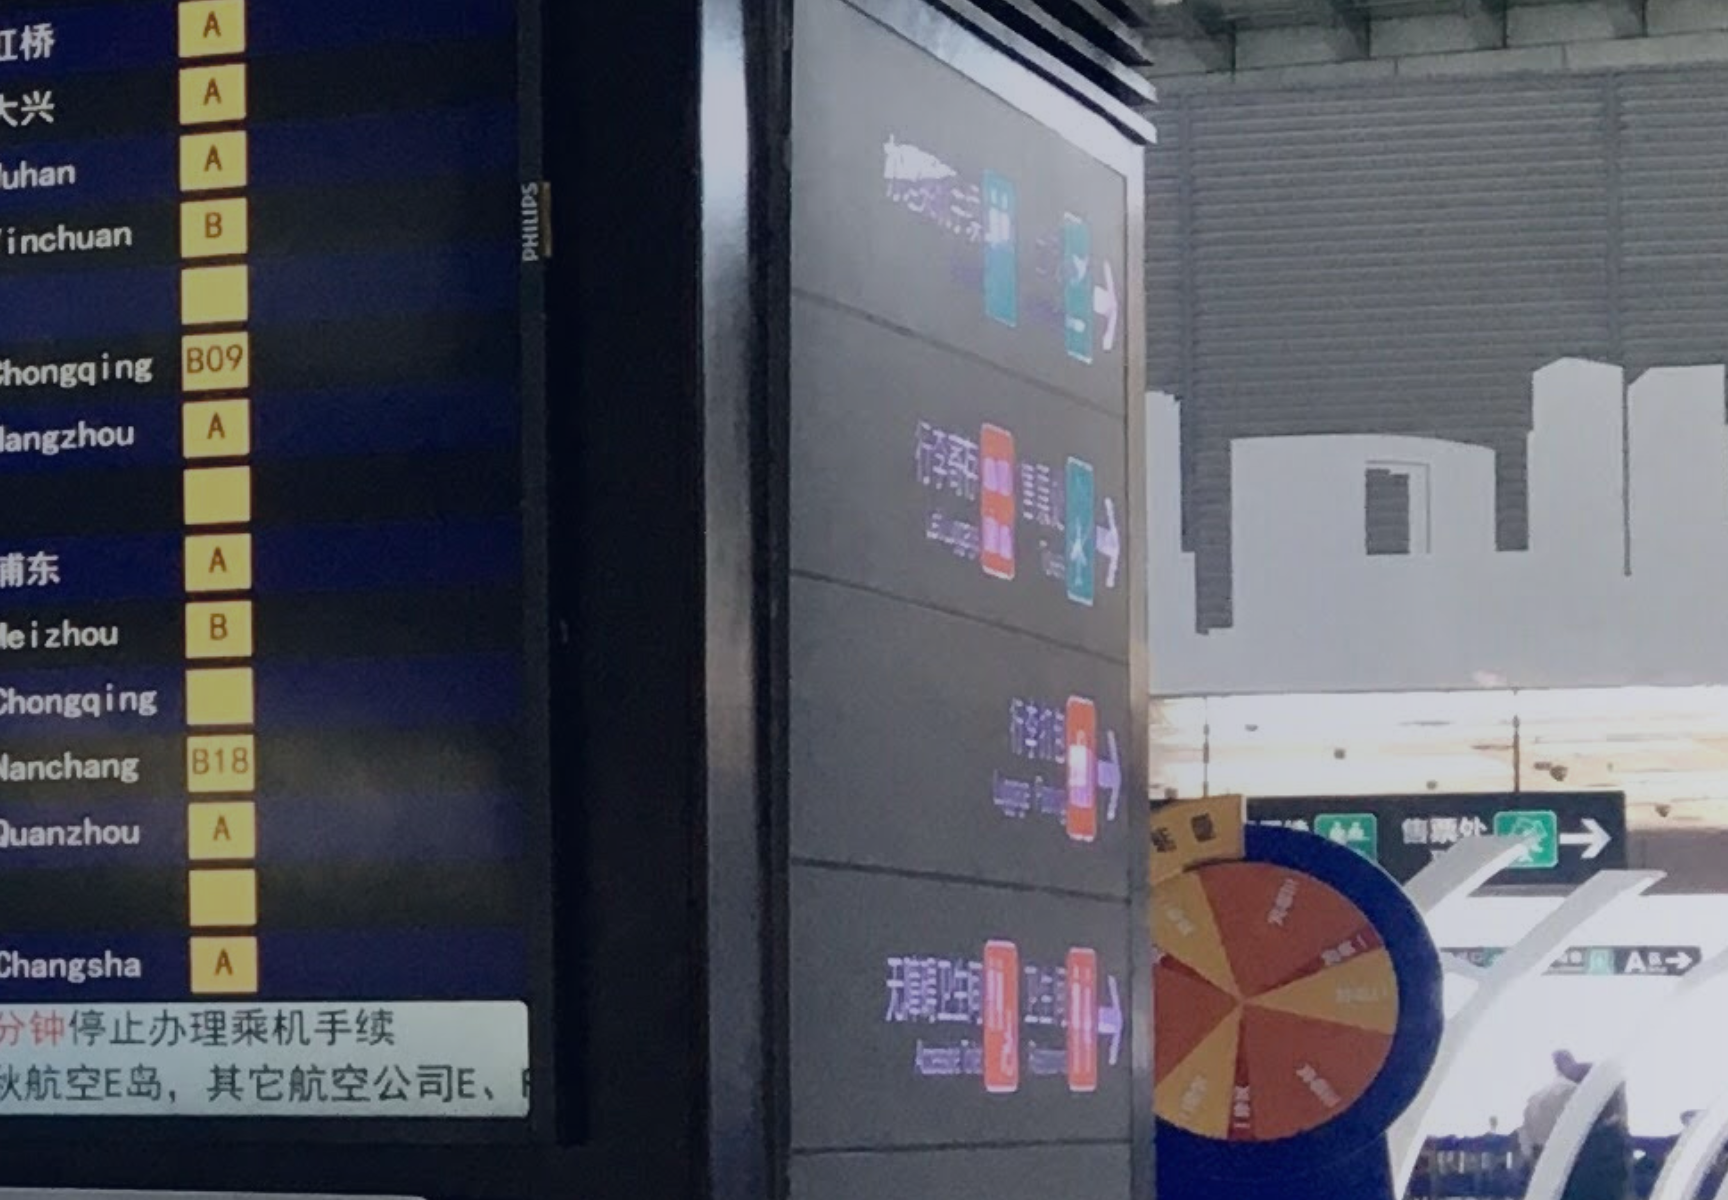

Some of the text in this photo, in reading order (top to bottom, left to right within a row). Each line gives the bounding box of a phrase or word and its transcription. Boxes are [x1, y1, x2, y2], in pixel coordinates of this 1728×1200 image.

[204, 12, 221, 37] A
[204, 79, 221, 104] A
[205, 146, 221, 171] A
[205, 212, 222, 238] B
[521, 182, 538, 261] PHILIPS
[187, 344, 243, 373] B09
[208, 413, 224, 439] A
[210, 548, 226, 572] A
[210, 614, 227, 640] B
[192, 747, 248, 774] B18
[214, 816, 230, 840] A
[216, 949, 232, 974] A
